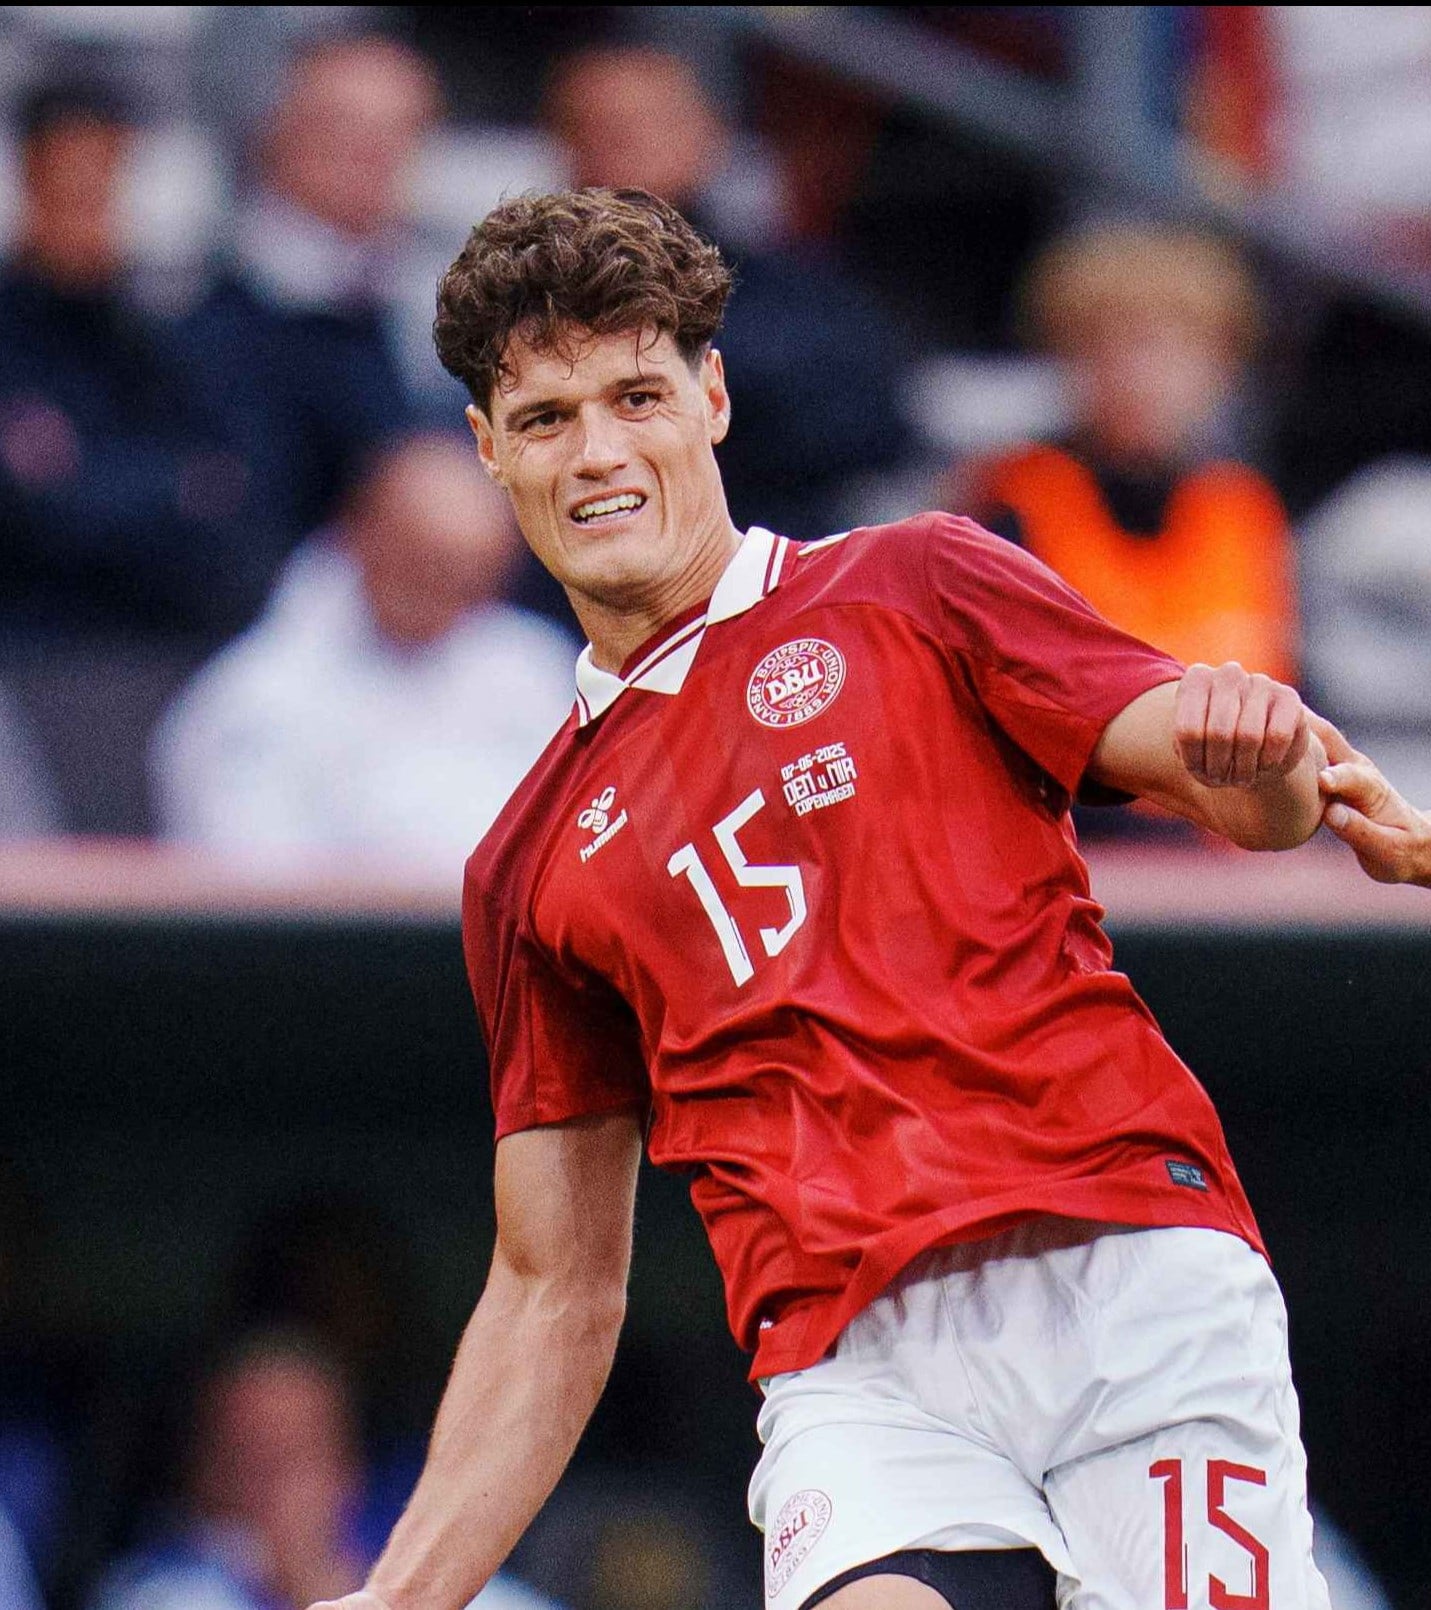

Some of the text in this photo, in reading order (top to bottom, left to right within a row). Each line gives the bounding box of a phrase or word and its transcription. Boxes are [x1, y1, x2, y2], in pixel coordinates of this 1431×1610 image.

[766, 659, 824, 705] DBU
[822, 649, 839, 694] UNION
[751, 683, 781, 723] DANSK
[786, 698, 823, 723] 1889
[781, 742, 846, 781] 07-06-2025
[782, 770, 817, 806] DEN
[826, 757, 857, 787] NIR
[795, 782, 855, 817] COPENHAGEN
[580, 808, 628, 863] hummel
[667, 788, 807, 988] 15
[1149, 1459, 1270, 1610] 15
